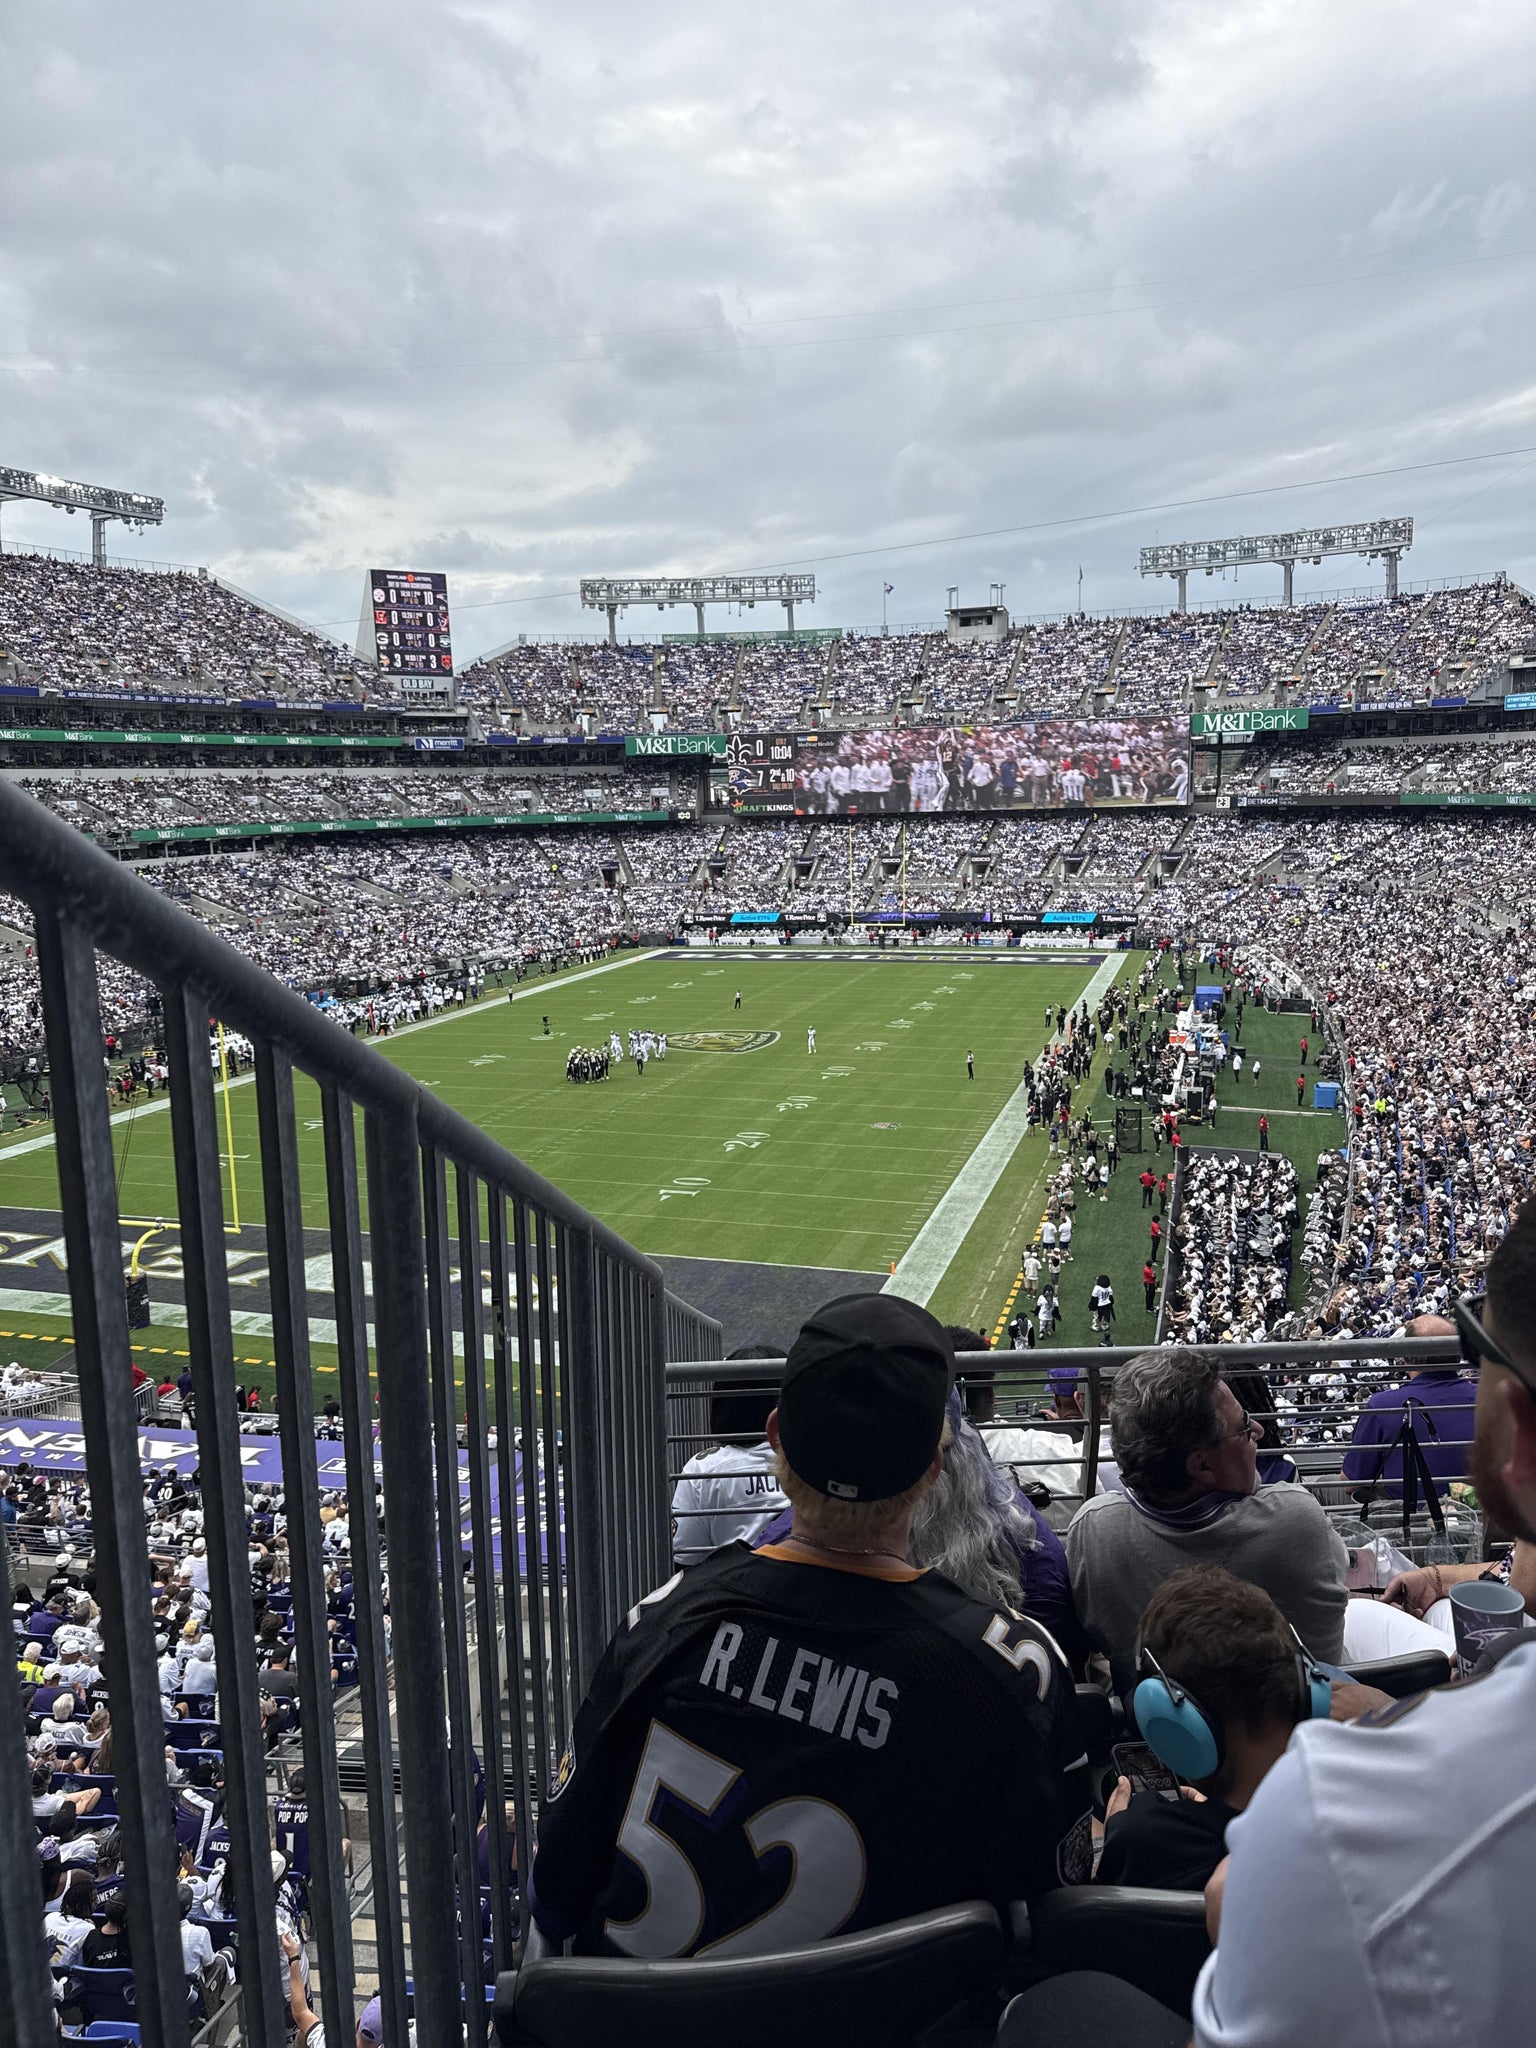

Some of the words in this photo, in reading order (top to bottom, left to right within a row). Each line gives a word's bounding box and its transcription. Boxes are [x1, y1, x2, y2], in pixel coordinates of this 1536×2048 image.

[390, 589, 397, 603] 0
[423, 591, 434, 606] 10
[391, 611, 399, 624] 0
[427, 612, 434, 626] 0
[393, 632, 400, 646] 0
[428, 634, 436, 648] 0
[394, 654, 402, 668] 3
[430, 655, 436, 668] 3
[403, 680, 417, 688] OLD
[418, 680, 433, 688] BAY
[1202, 712, 1250, 732] M&T
[1251, 710, 1296, 730] Bank
[636, 738, 676, 754] M&T
[677, 736, 717, 753] Bank
[756, 740, 763, 756] 0
[770, 746, 792, 759] 10:04
[943, 752, 952, 762] 12
[757, 770, 763, 787] 7
[770, 768, 780, 782] 2nd
[786, 768, 794, 782] 10
[734, 804, 794, 813] DRAFTKINGS
[822, 1066, 856, 1078] 40
[776, 1096, 817, 1110] 30
[723, 1132, 770, 1150] 20
[659, 1177, 712, 1199] 10
[158, 1488, 173, 1500] 20
[64, 1629, 86, 1638] JOHNSON
[700, 1621, 899, 1750] R.LEWIS
[91, 1690, 109, 1699] JACKSO
[278, 1810, 291, 1823] POP
[294, 1811, 309, 1824] POP
[604, 1718, 868, 1958] 52
